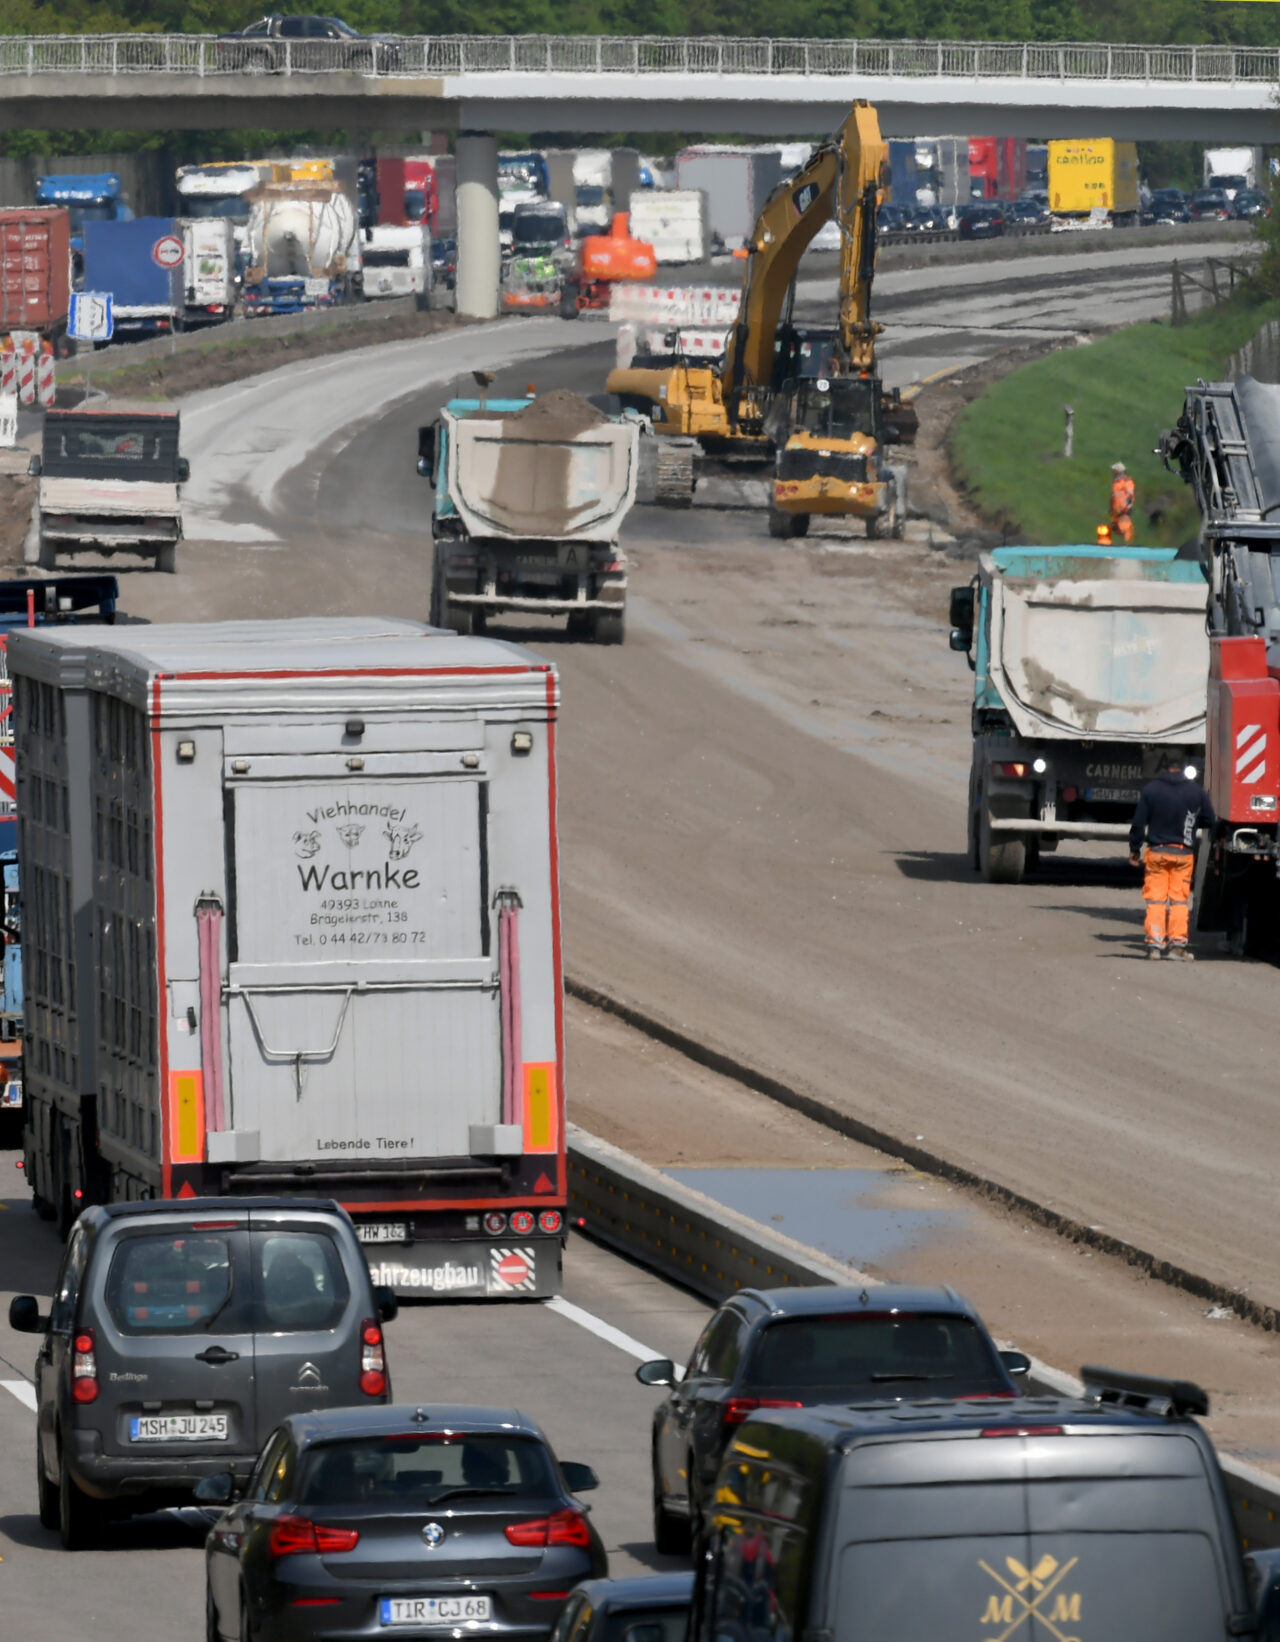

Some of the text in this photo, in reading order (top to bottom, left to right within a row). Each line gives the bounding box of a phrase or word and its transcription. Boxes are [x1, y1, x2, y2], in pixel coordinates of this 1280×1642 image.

[1086, 763, 1143, 780] CARNEHL
[306, 801, 406, 824] Viehhandel
[297, 861, 420, 892] Warnke
[320, 899, 360, 911] 49393
[320, 934, 327, 945] 0
[330, 934, 346, 945] 44
[392, 932, 408, 944] 80
[411, 931, 427, 944] 72
[317, 1137, 415, 1150] Lebende Tiere!
[363, 1225, 379, 1239] HW
[139, 1416, 225, 1436] MSH JU 245
[393, 1600, 486, 1618] TIR CJ 68
